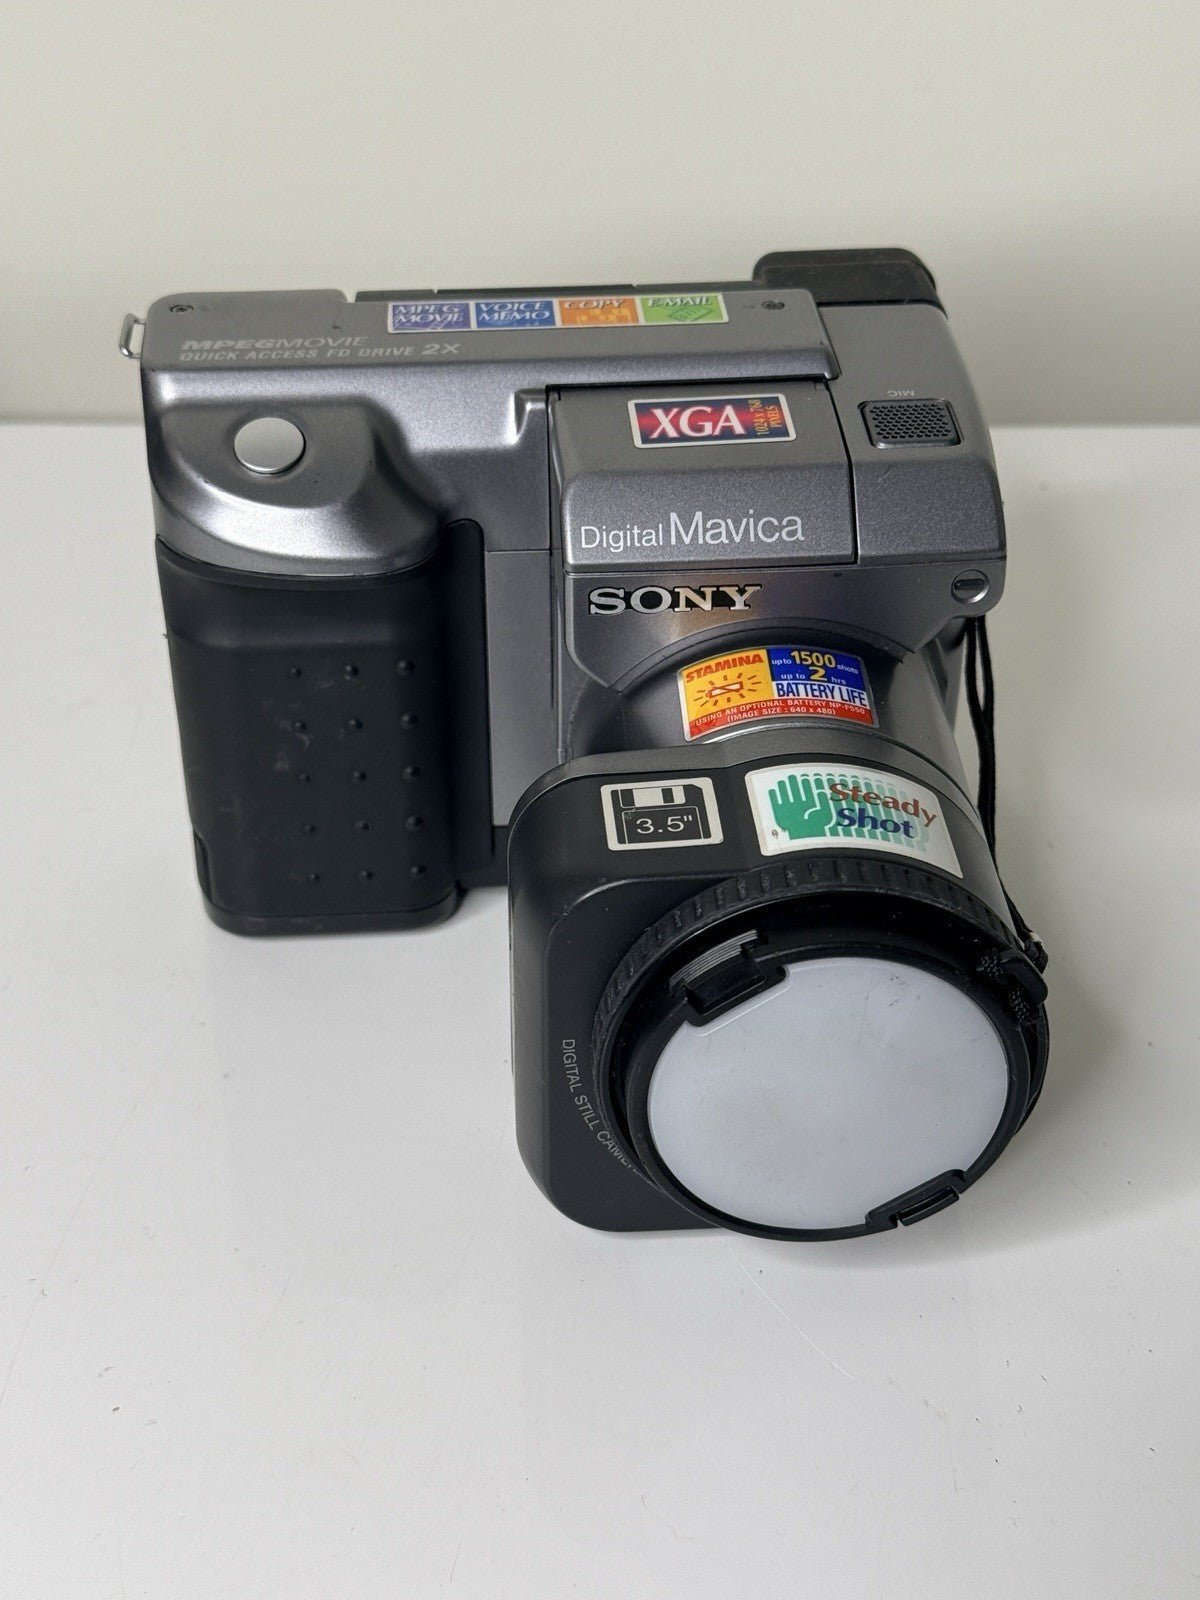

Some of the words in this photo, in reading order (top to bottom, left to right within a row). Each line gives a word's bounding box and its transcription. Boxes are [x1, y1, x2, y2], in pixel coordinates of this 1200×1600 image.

[396, 304, 461, 314] MPEG
[479, 301, 546, 312] VOICE
[564, 299, 627, 310] COPY
[396, 313, 464, 323] MOVIE
[479, 310, 550, 321] MEMO
[180, 351, 239, 361] QUICK
[244, 349, 319, 360] ACCESS
[326, 348, 351, 358] FD
[358, 345, 416, 357] DRIVE
[422, 342, 460, 355] 2X
[182, 336, 370, 351] MPEGMOVIE
[887, 389, 915, 398] MIC
[649, 404, 747, 439] XGA
[753, 418, 769, 435] 1024
[765, 405, 783, 428] PIXELS
[580, 523, 663, 552] Digital
[669, 509, 805, 545] Mavica
[588, 584, 762, 615] SONY
[685, 653, 764, 683] STAMINA
[790, 650, 836, 668] 1500
[836, 664, 859, 675] shots
[808, 666, 827, 681] 2
[831, 676, 847, 685] hrs
[775, 682, 835, 700] BATTERY
[839, 686, 868, 707] LIFE
[695, 711, 722, 726] USING
[725, 707, 737, 715] AN
[740, 700, 785, 711] OPTIONAL
[727, 710, 760, 723] (IMAGE
[762, 707, 781, 715] SIZE
[816, 707, 836, 715] 480)
[829, 782, 938, 827] Steady
[635, 815, 693, 835] 3.5"
[836, 807, 916, 839] Shot
[562, 1038, 583, 1093] DIGITAL
[574, 1094, 600, 1131] STILL
